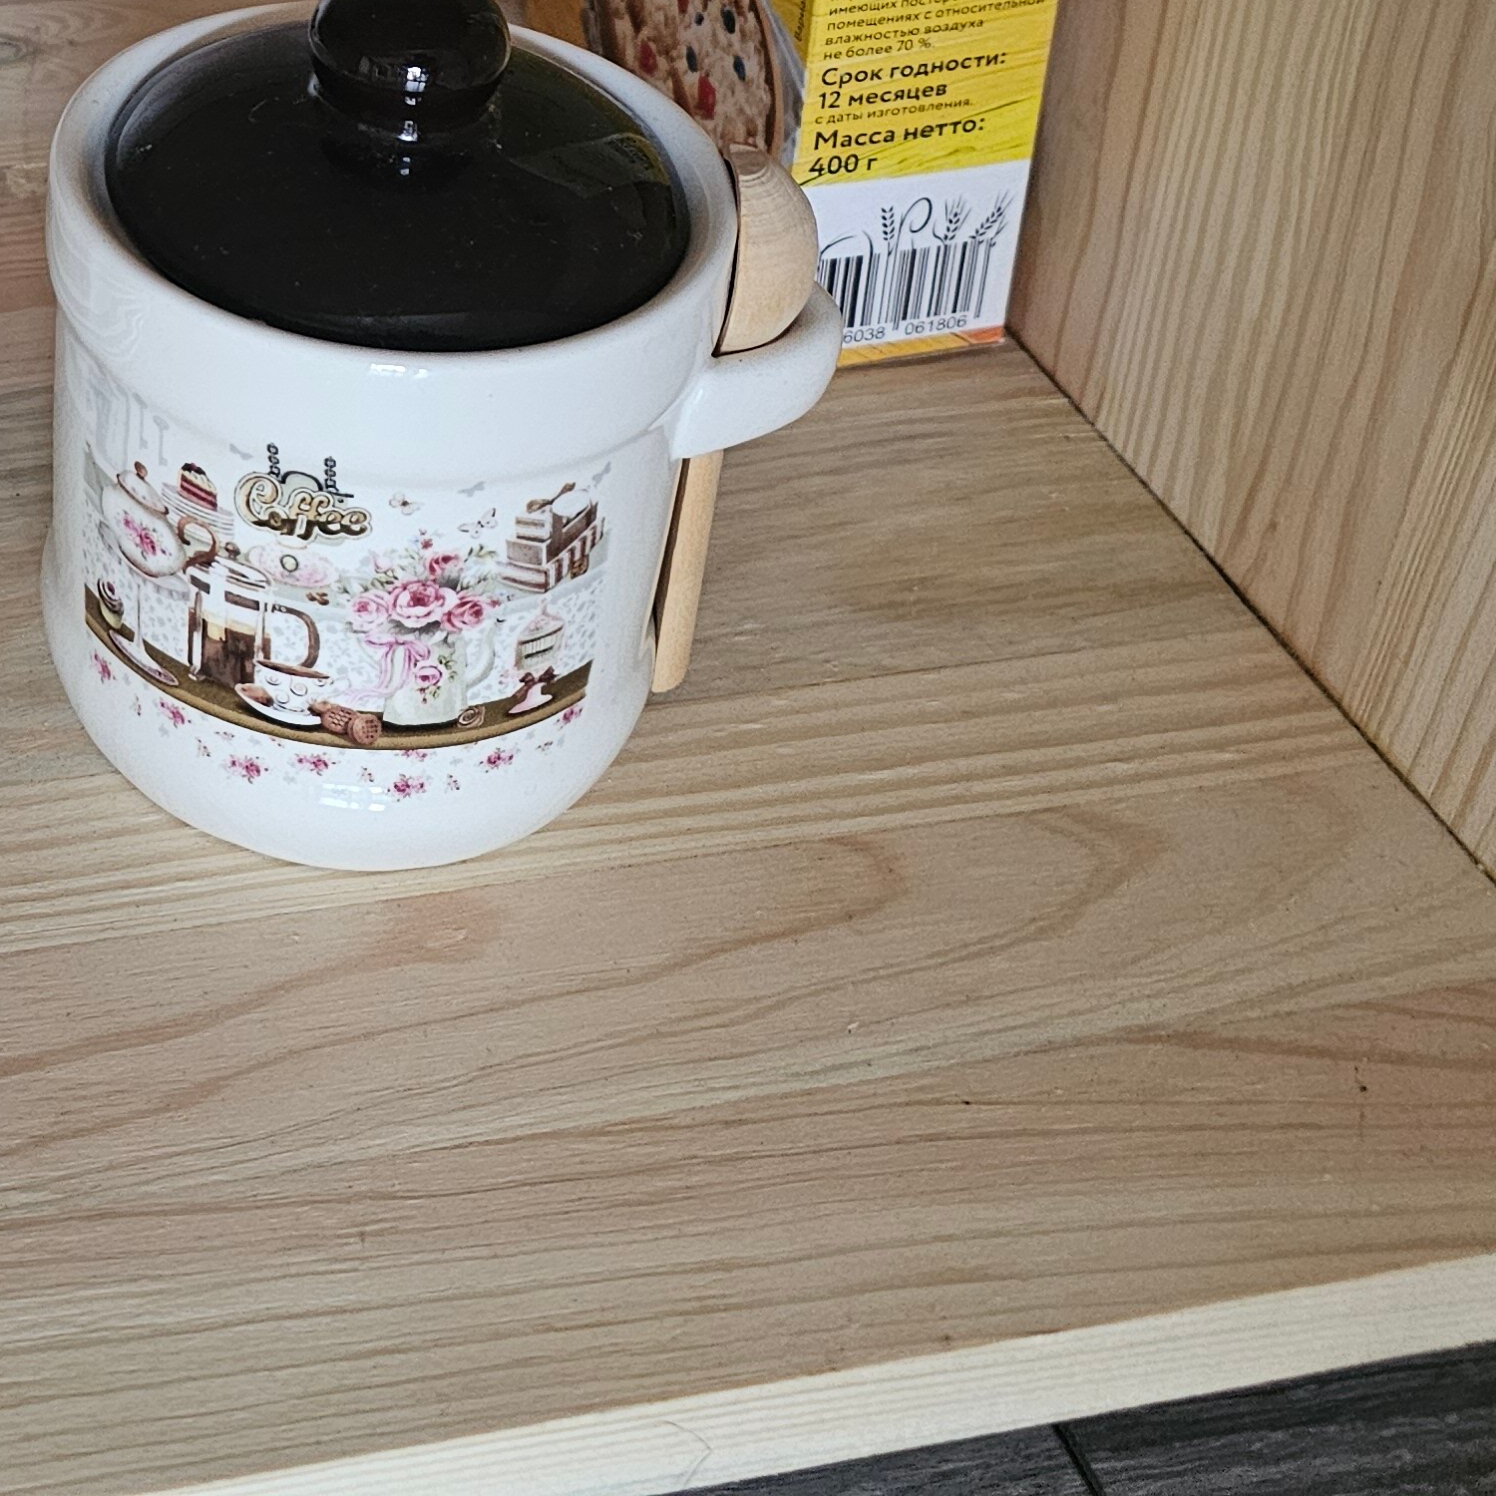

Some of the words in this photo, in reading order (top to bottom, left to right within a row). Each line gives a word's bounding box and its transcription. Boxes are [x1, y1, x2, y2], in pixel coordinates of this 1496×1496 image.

[827, 12, 920, 32] помещениях
[924, 10, 933, 20] с
[829, 0, 898, 17] имеющих
[825, 27, 920, 46] влажностью
[924, 19, 984, 35] воздуха
[823, 49, 842, 61] не
[845, 44, 893, 59] более
[896, 39, 915, 52] 70
[821, 64, 883, 88] Срок
[889, 52, 1007, 78] годности:
[819, 91, 842, 109] 12
[848, 84, 948, 106] месяцев
[815, 115, 824, 124] с
[826, 110, 864, 126] даты
[867, 98, 973, 119] изготовления.
[814, 126, 895, 150] Масса
[903, 117, 986, 141] нетто:
[808, 155, 859, 177] 400
[867, 158, 878, 171] г
[904, 315, 968, 336] 061806
[236, 472, 372, 542] Coffee
